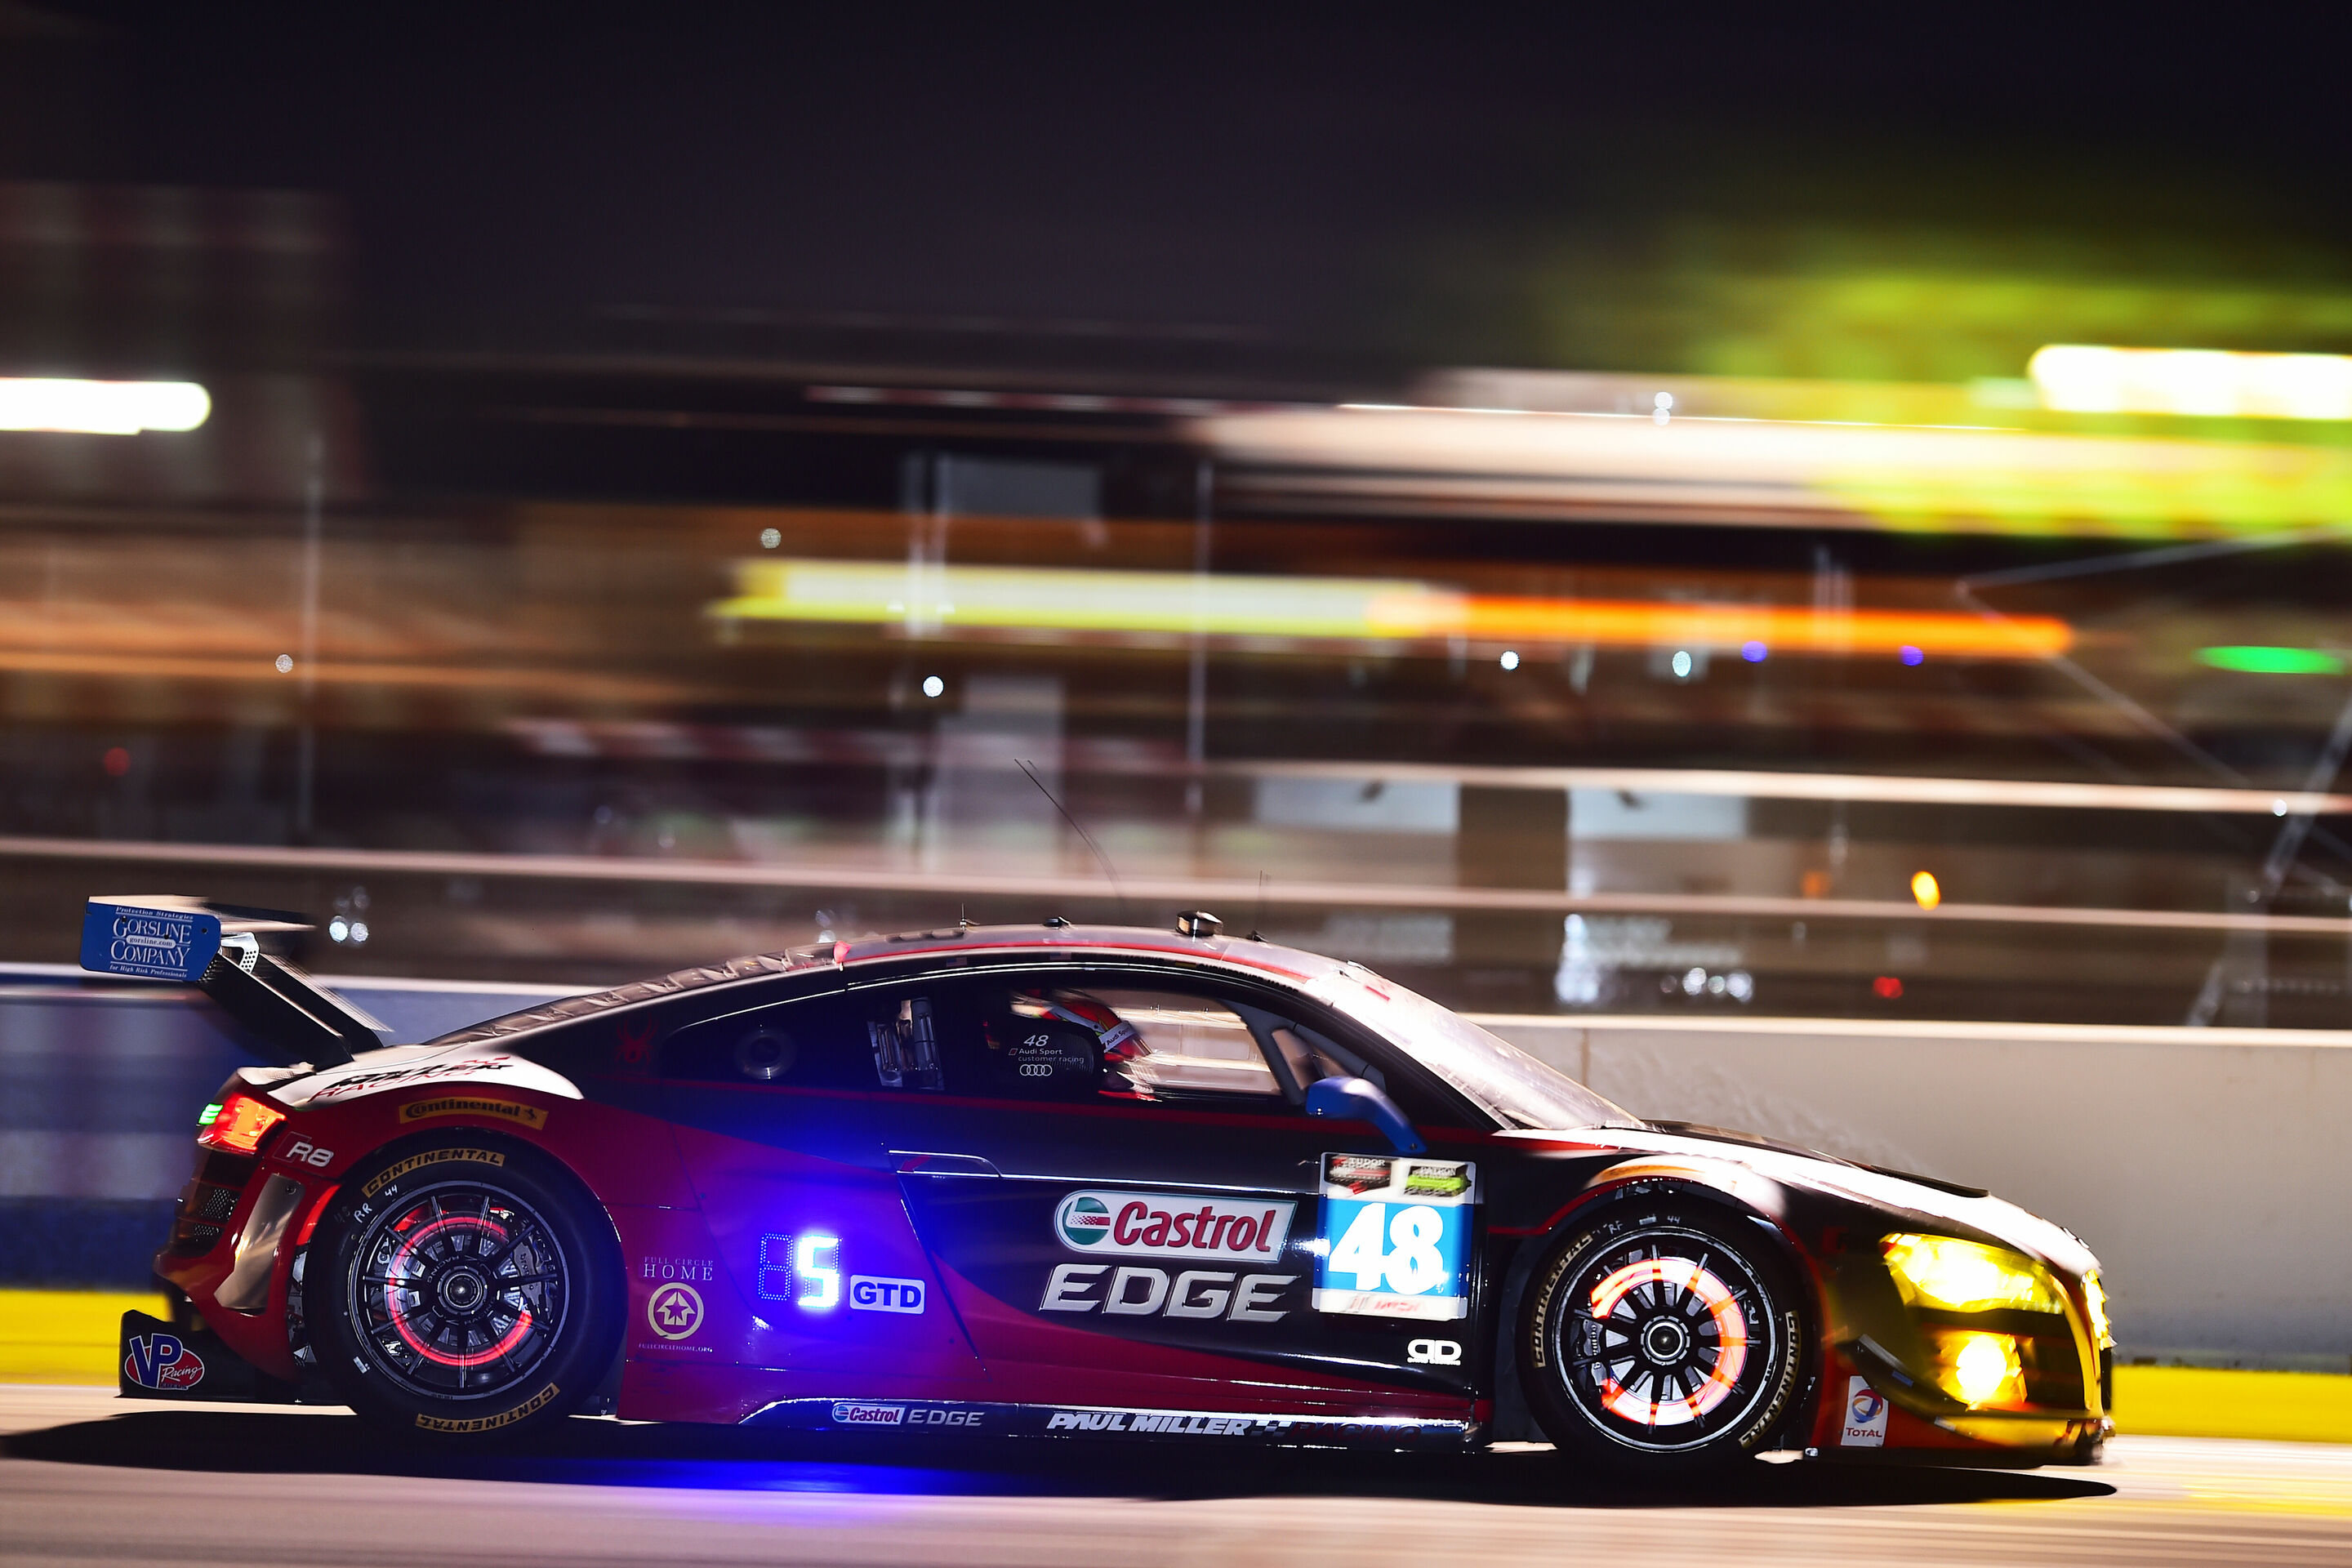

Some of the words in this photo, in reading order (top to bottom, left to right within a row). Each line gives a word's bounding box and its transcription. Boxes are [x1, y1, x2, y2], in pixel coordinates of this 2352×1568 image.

[116, 906, 154, 915] Protection
[156, 911, 194, 920] Strategies
[113, 918, 192, 944] GORSLINE
[129, 937, 172, 947] gorsline.com
[110, 939, 190, 967] COMPANY
[150, 969, 187, 978] Professionals
[1023, 1035, 1049, 1047] 48
[1039, 1048, 1063, 1056] Sport
[1058, 1056, 1085, 1064] racing
[406, 1099, 520, 1119] Continental
[287, 1142, 335, 1168] R8
[368, 1149, 501, 1195] CONTINENTAL
[385, 1185, 399, 1197] 44
[354, 1203, 373, 1223] RR
[1667, 1214, 1682, 1224] 44
[1114, 1201, 1277, 1252] Castrol
[1328, 1201, 1445, 1295] 48
[643, 1263, 713, 1281] HOME
[644, 1256, 670, 1265] FULL
[675, 1258, 713, 1267] CIRCLE
[853, 1281, 922, 1308] GTD
[1039, 1263, 1301, 1322] EDGE
[1534, 1234, 1592, 1366] CONTINENTAL
[129, 1333, 184, 1389] VP
[161, 1365, 203, 1383] Racing
[1742, 1315, 1799, 1444] CONTINENTAL
[421, 1390, 555, 1432] CONTINENTAL
[849, 1406, 901, 1423] Castrol
[907, 1409, 986, 1427] EDGE
[1047, 1411, 1128, 1431] PAUL
[1130, 1414, 1254, 1437] MILLER
